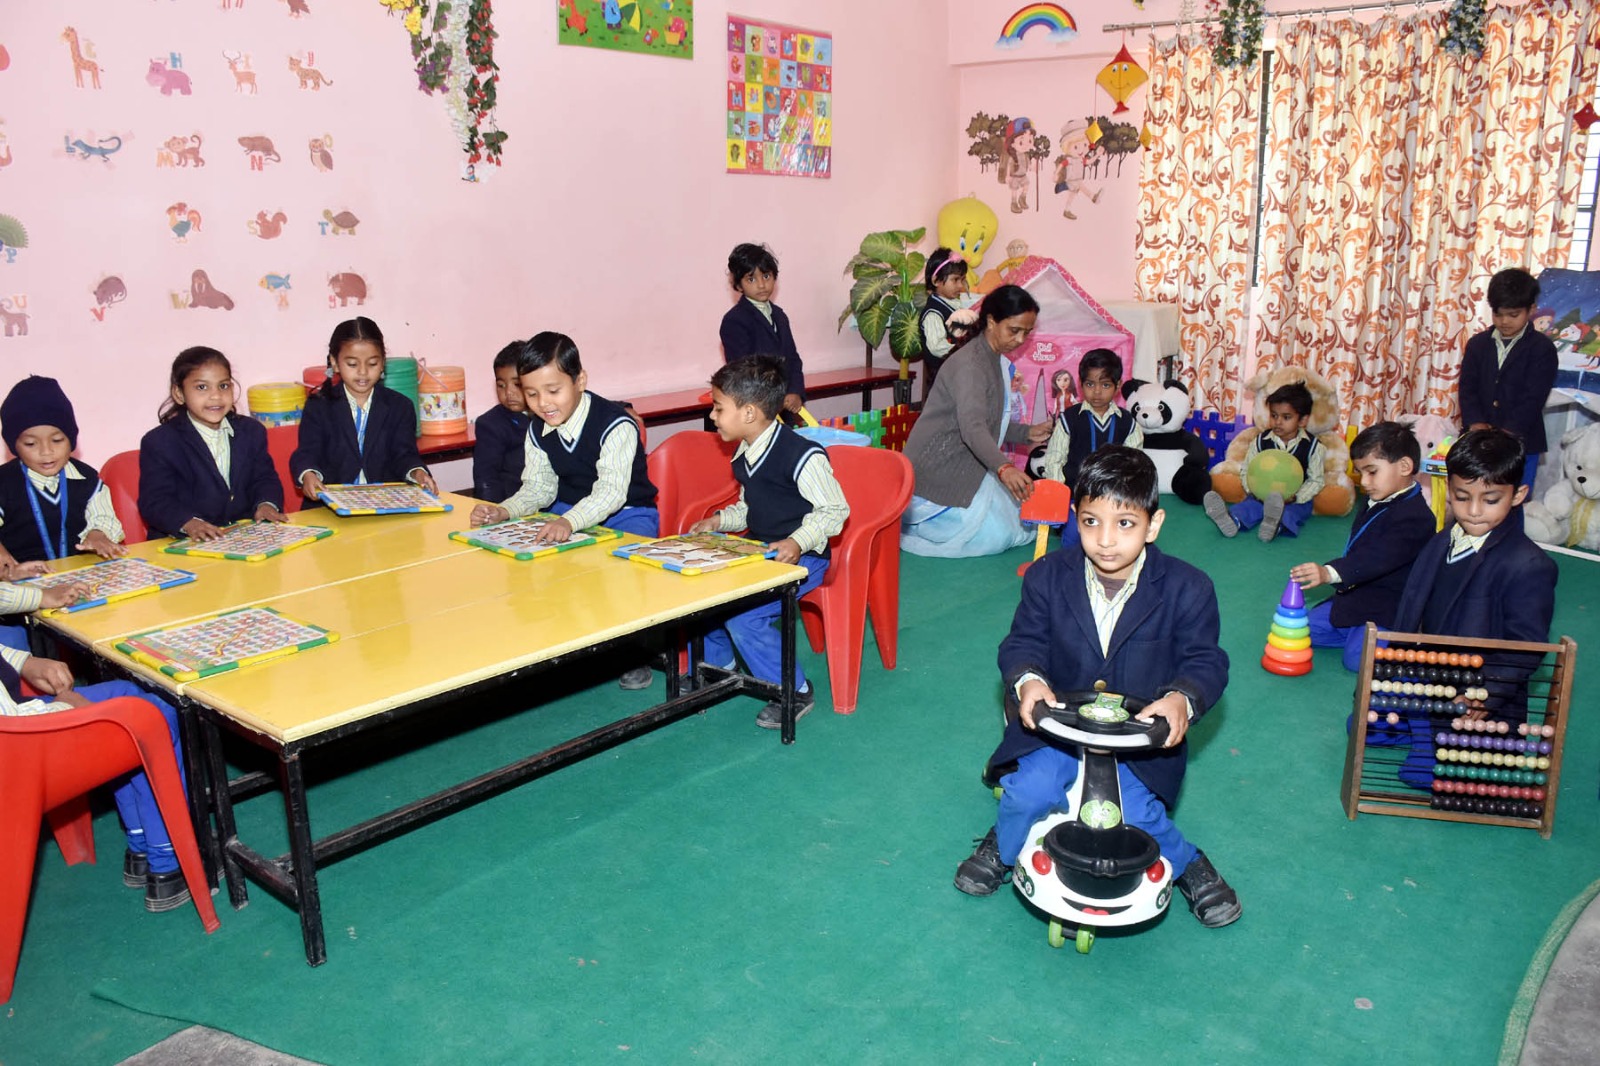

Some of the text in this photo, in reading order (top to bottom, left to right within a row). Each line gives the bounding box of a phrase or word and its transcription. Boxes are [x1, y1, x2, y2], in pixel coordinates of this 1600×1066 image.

[170, 52, 182, 69] H
[64, 135, 76, 153] L
[156, 151, 175, 168] M
[250, 155, 263, 171] N
[247, 220, 258, 235] S
[318, 221, 329, 235] T
[5, 248, 17, 263] P
[13, 295, 27, 309] U
[170, 293, 190, 309] W
[90, 306, 106, 321] V
